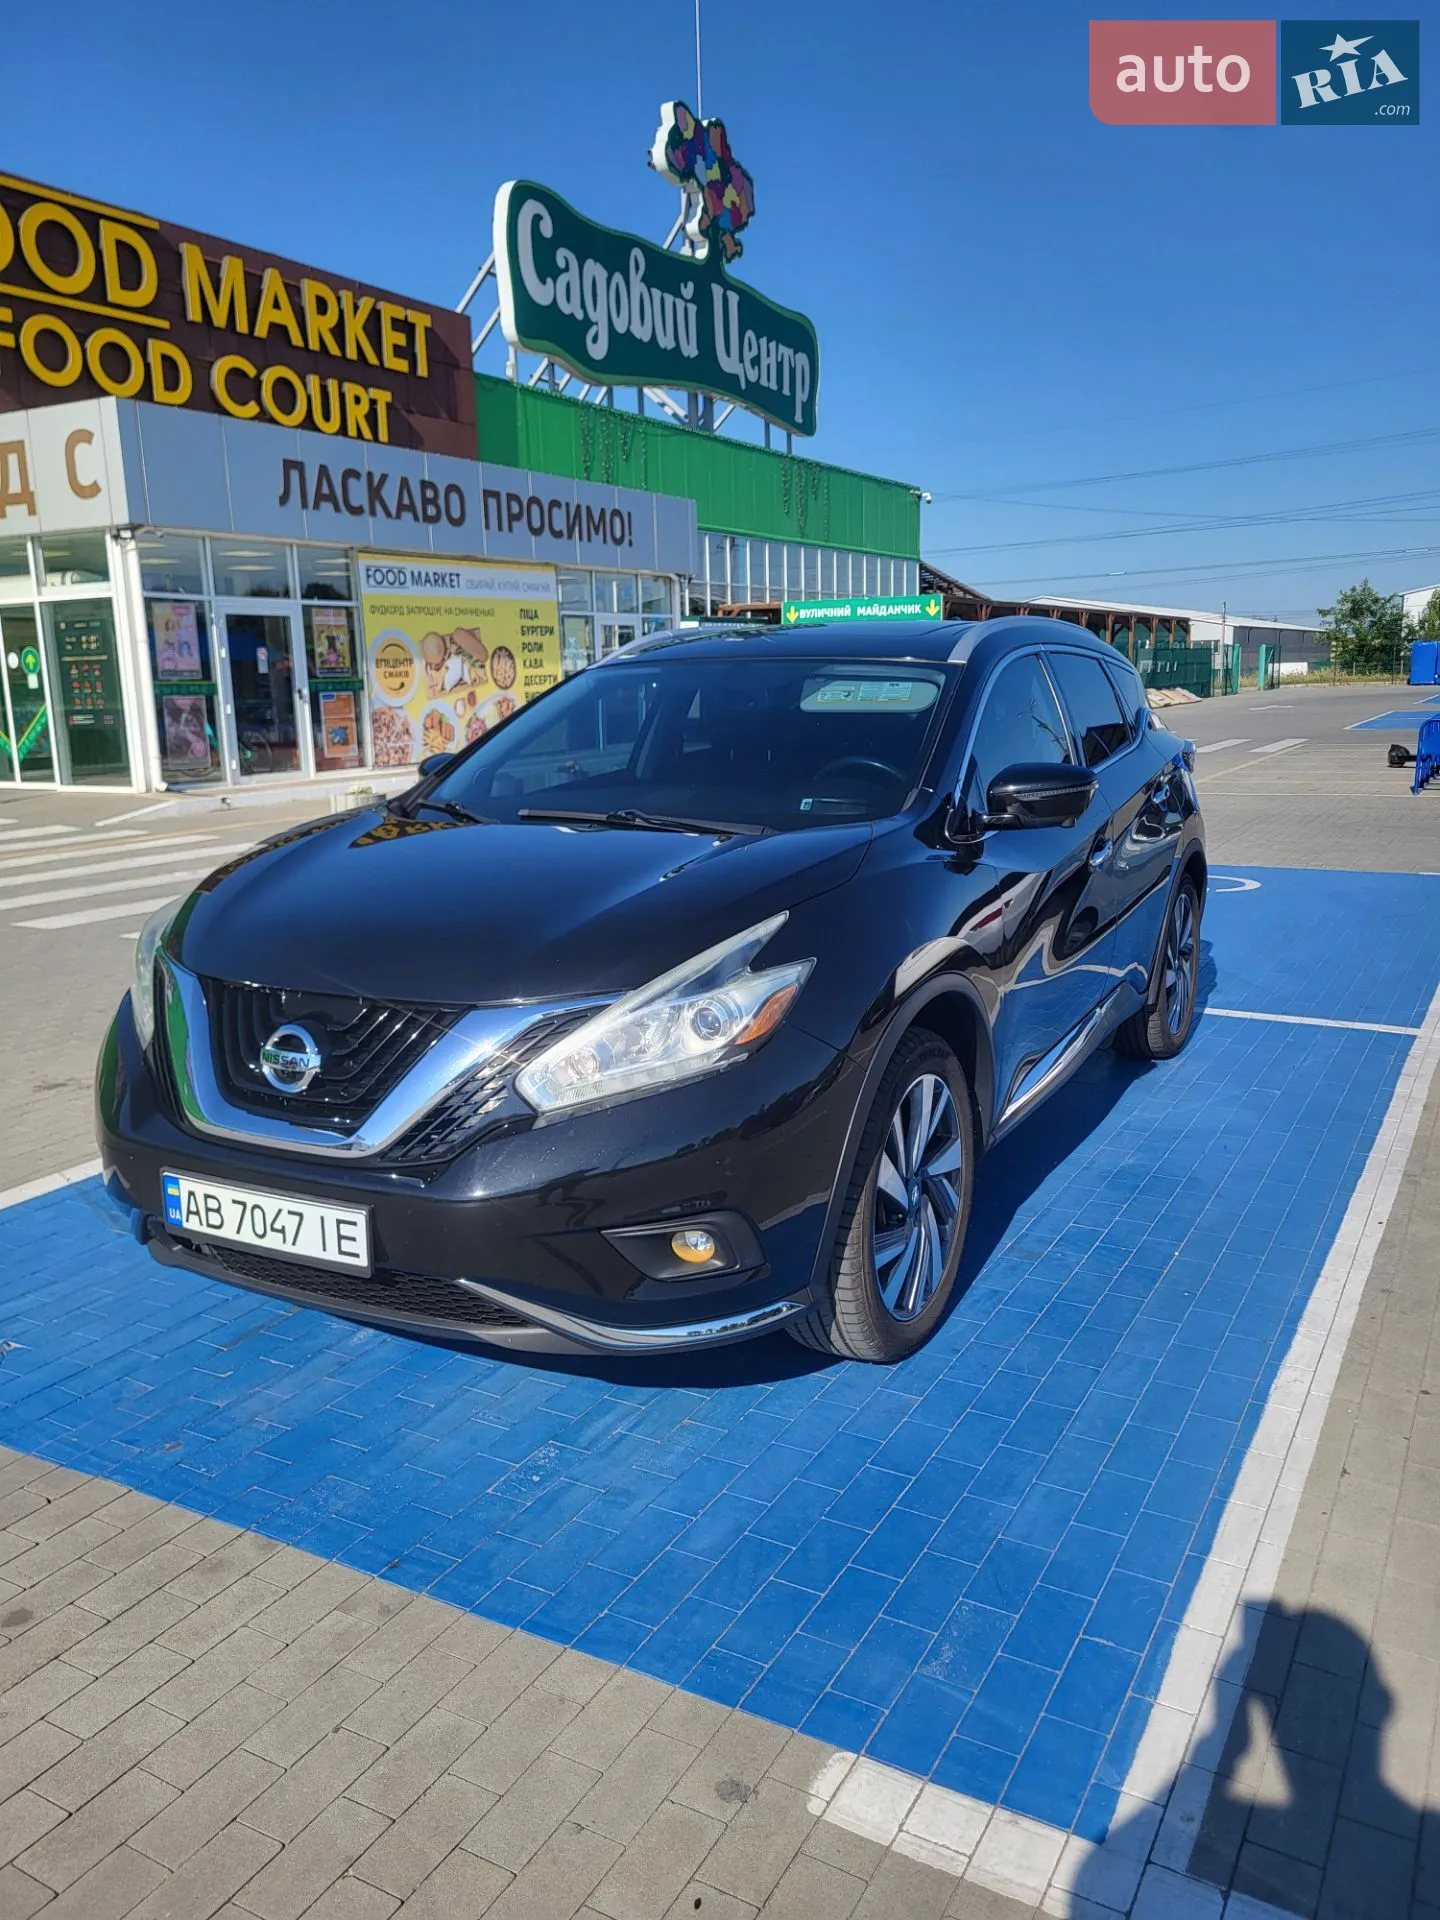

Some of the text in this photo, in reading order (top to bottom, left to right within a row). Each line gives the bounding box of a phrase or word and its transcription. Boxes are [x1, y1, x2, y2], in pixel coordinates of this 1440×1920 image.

[0, 200, 432, 378] OD MARKET
[517, 199, 810, 423] Садовий Центр
[210, 354, 392, 443] COURT
[279, 458, 633, 547] ЛАСКАВО ПРОСИМО!
[365, 567, 461, 588] FOOD MARKET
[800, 603, 921, 619] ВУЛИЧНИЙ МАЙДАНЧИК
[520, 625, 555, 637] БУРГЕРИ
[522, 642, 544, 653] РОЛИ
[523, 658, 544, 669] КАВА
[262, 1050, 310, 1068] NISSAN
[168, 1208, 182, 1220] UA
[185, 1190, 360, 1259] AB 7047 IE
